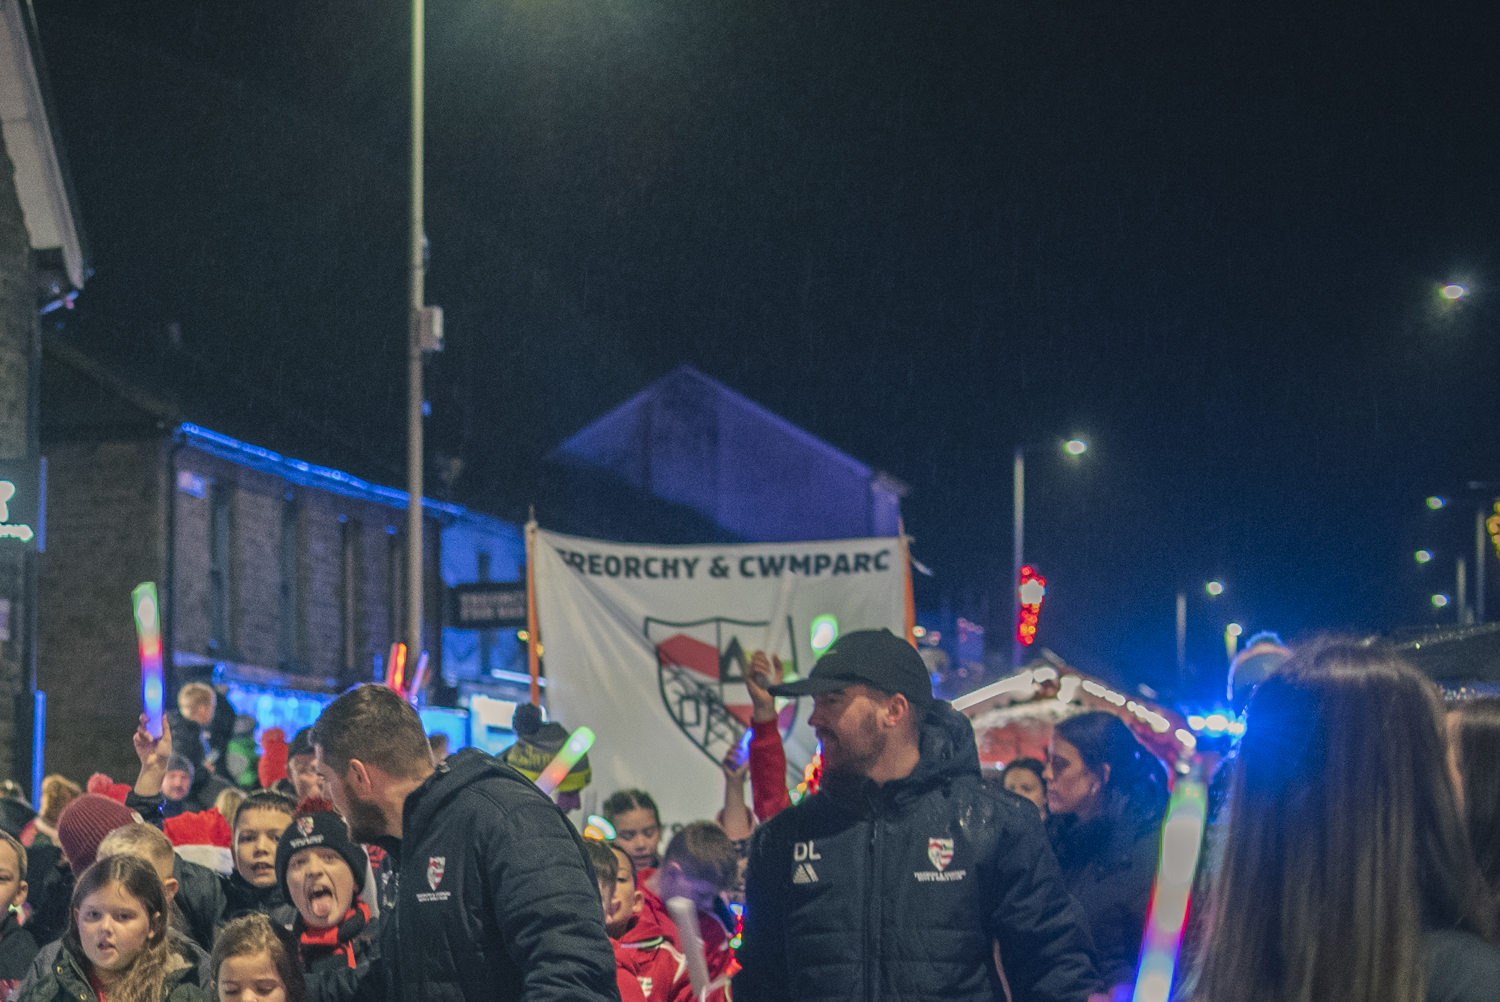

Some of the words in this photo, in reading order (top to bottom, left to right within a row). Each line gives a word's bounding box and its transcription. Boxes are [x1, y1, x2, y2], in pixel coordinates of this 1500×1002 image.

[709, 555, 730, 579] &
[739, 549, 891, 578] CWMPARC
[794, 840, 822, 862] DL
